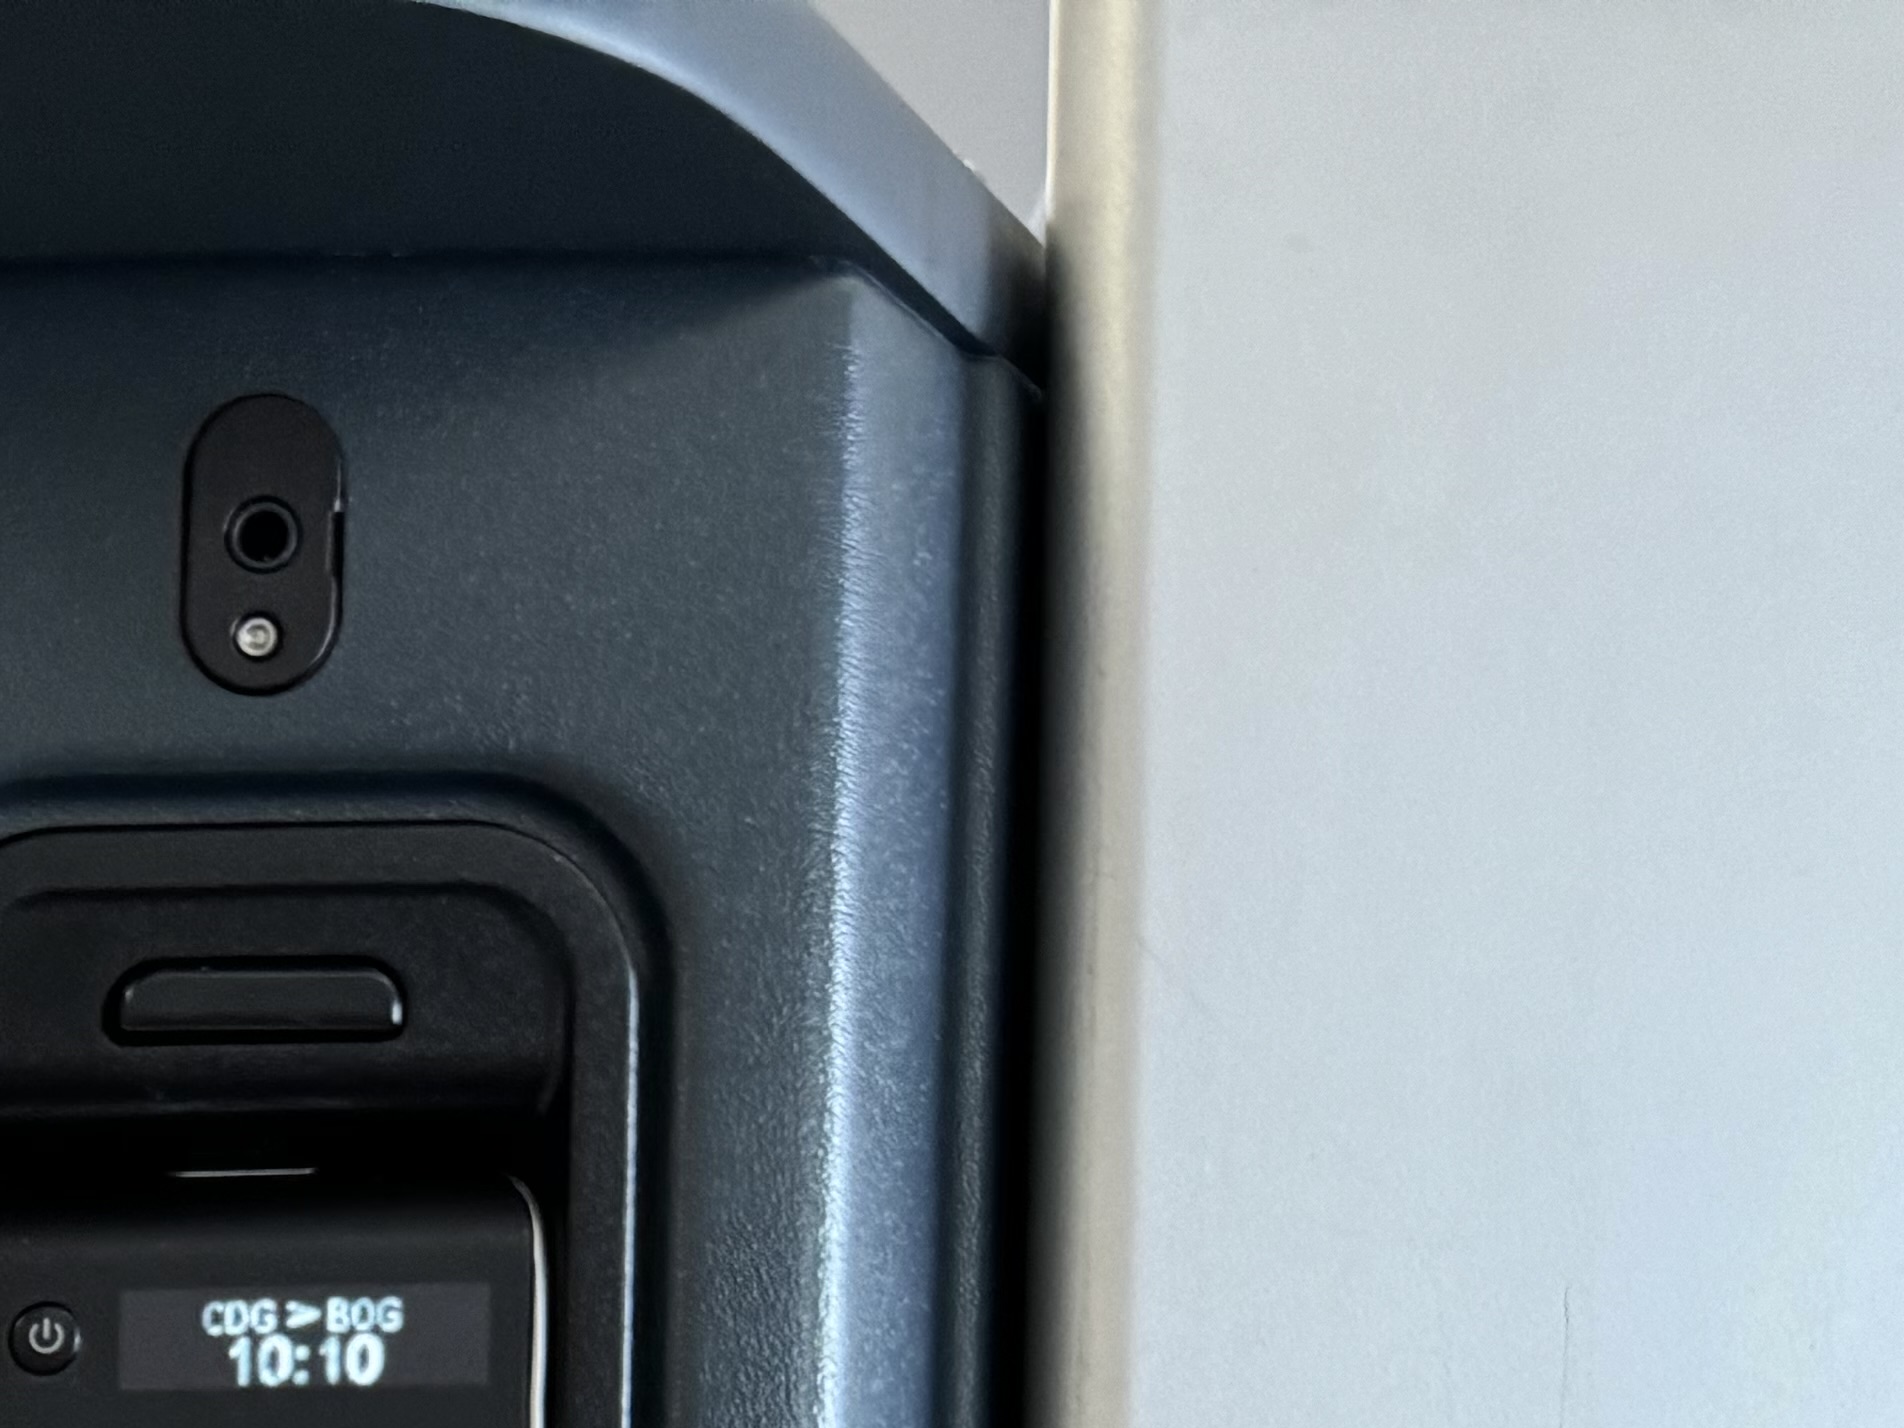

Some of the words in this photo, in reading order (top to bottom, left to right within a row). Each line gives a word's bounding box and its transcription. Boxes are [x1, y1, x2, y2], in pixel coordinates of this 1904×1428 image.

[202, 1298, 279, 1337] CDG
[326, 1296, 405, 1334] BOG
[228, 1332, 385, 1388] 10:10
